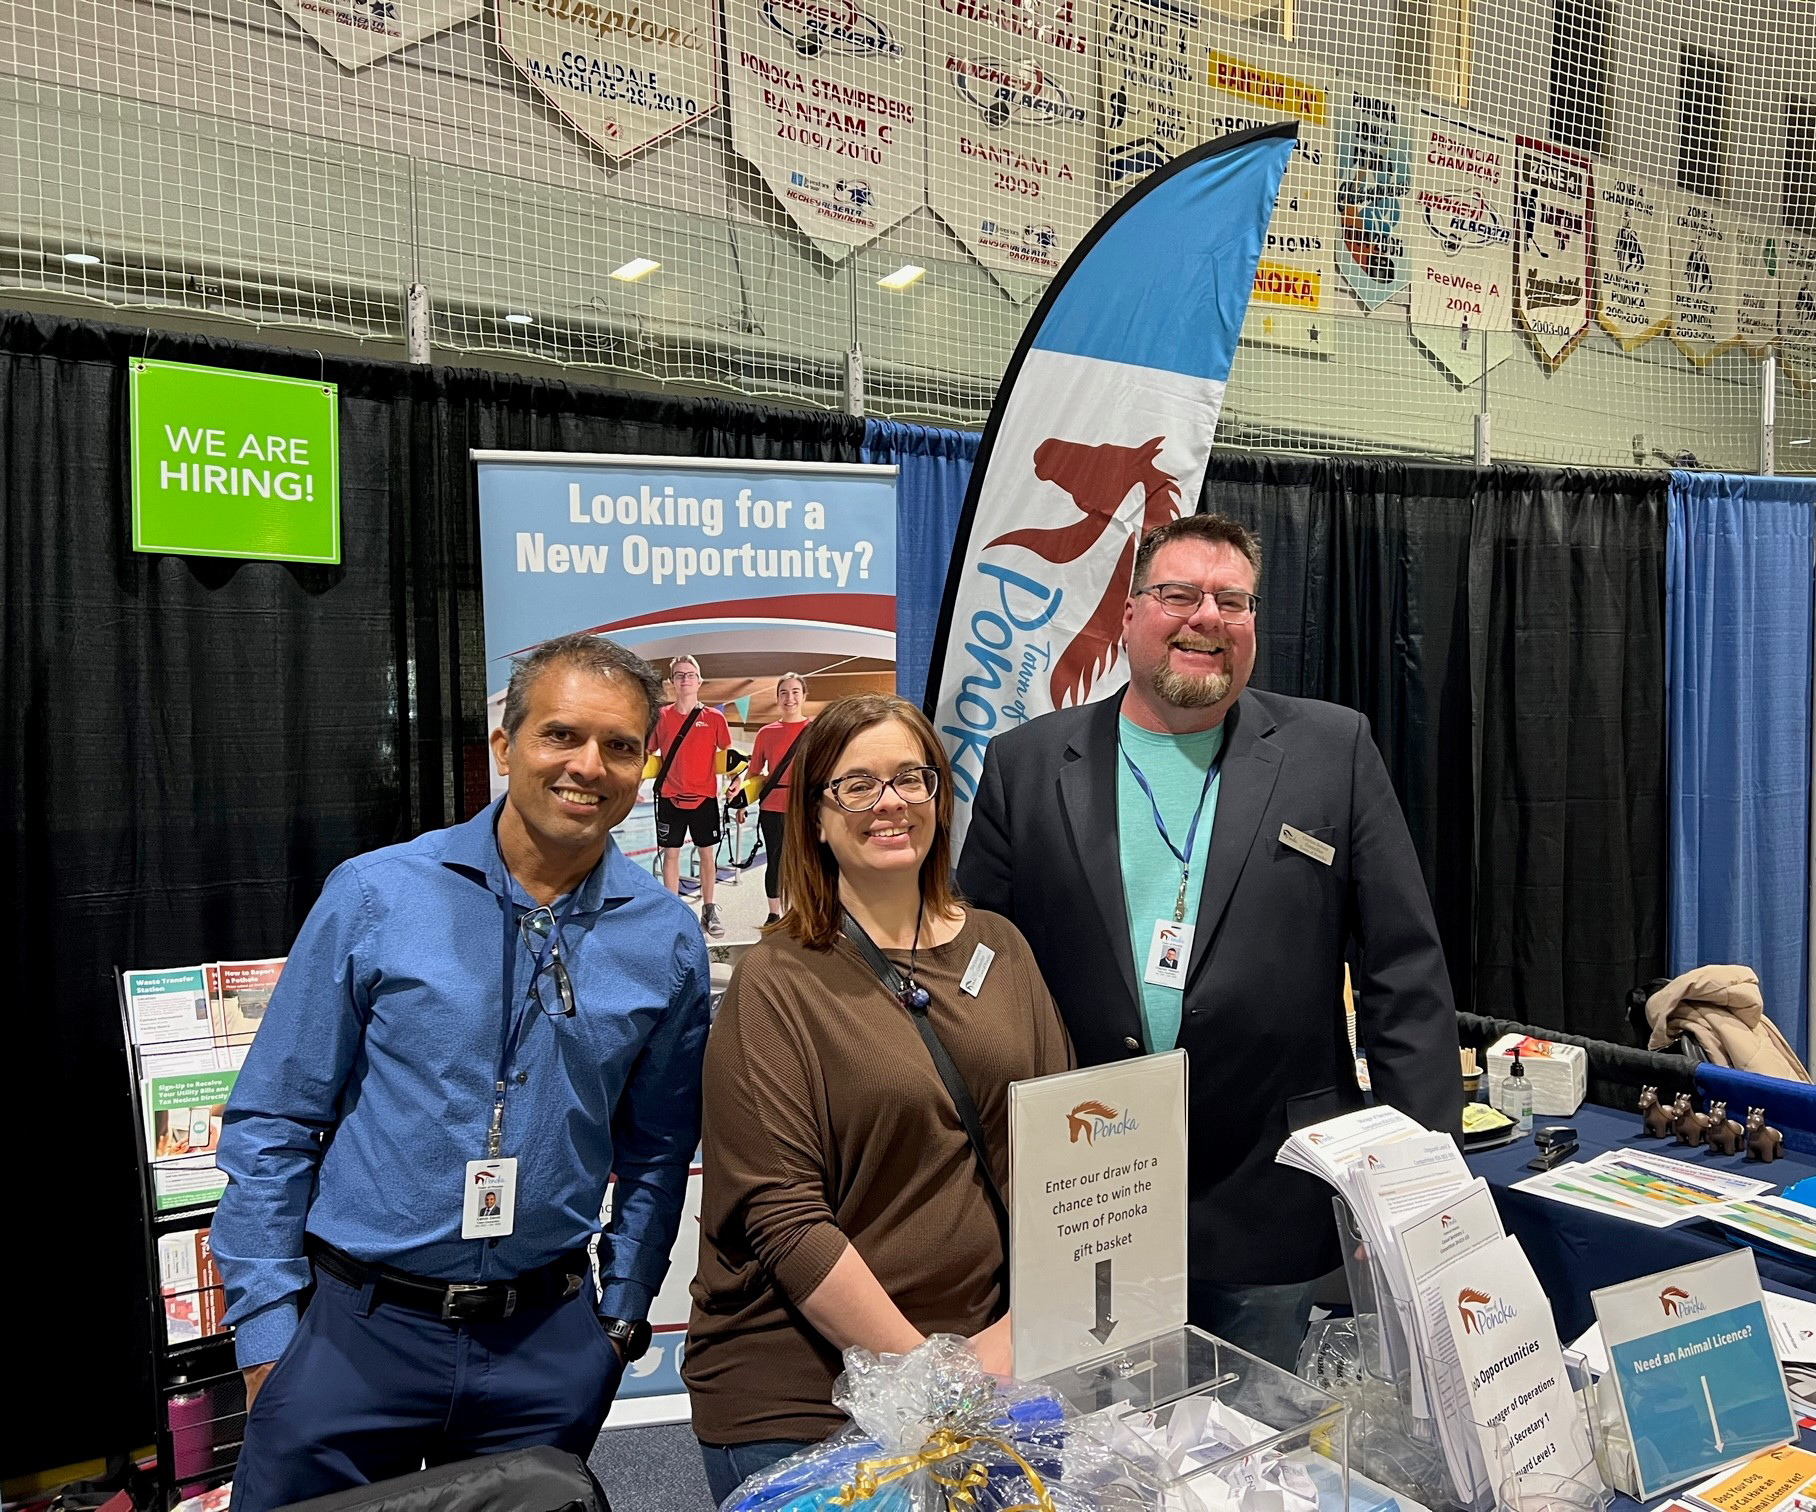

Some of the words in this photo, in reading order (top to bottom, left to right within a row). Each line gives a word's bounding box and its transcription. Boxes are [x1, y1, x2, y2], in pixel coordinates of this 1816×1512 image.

[510, 0, 703, 50] ampions
[1110, 4, 1168, 48] ZONE
[1176, 28, 1187, 54] 4
[562, 51, 657, 91] COALDALE
[946, 55, 1032, 92] HOCKEY
[1104, 35, 1192, 82] CHAMPIONS
[526, 58, 592, 95] MARCH
[740, 51, 804, 93] PONOKA
[812, 78, 915, 124] STAMPEDERS
[1218, 63, 1284, 105] BANTAM
[764, 88, 866, 137] BANTAM
[878, 125, 893, 145] C
[1353, 91, 1397, 124] PONOKA
[776, 119, 882, 165] 2009/2010
[1153, 117, 1186, 142] 2007
[960, 137, 1049, 175] BANTAM
[1058, 163, 1073, 180] A
[1430, 132, 1501, 166] PROVINCIAL
[994, 172, 1040, 197] 2009
[1427, 150, 1501, 185] CHAMPIONS
[1289, 196, 1298, 212] 4
[1602, 190, 1654, 216] CHAMPIONS
[1614, 181, 1637, 196] ZONE
[1267, 234, 1321, 252] PIONS
[1253, 269, 1315, 302] NOKA
[1427, 267, 1482, 294] PeeWee
[1489, 284, 1500, 297] A
[1445, 298, 1482, 316] 2004
[1531, 319, 1570, 337] 2003-04
[164, 424, 226, 457] WE
[237, 433, 310, 465] ARE
[160, 460, 314, 502] HIRING!
[568, 483, 724, 536] Looking
[736, 488, 792, 529] for
[804, 501, 825, 530] a
[515, 532, 609, 574] New
[622, 535, 874, 588] Opportunity?
[942, 562, 1063, 803] Ponoka
[1016, 641, 1050, 698] Town
[161, 976, 194, 984] Transfer
[251, 969, 275, 977] Report
[158, 1083, 186, 1091] Sign-Up
[173, 1096, 199, 1104] Notices
[200, 1093, 228, 1101] Directly
[1093, 1108, 1140, 1141] Ponoka
[1046, 1176, 1077, 1194] Enter
[1080, 1172, 1100, 1186] our
[1103, 1164, 1131, 1181] draw
[1133, 1158, 1149, 1173] for
[1151, 1157, 1158, 1167] a
[1052, 1197, 1093, 1215] chance
[1097, 1193, 1109, 1204] to
[1111, 1187, 1131, 1200] win
[1133, 1180, 1152, 1194] the
[1057, 1221, 1090, 1238] Town
[1092, 1215, 1104, 1228] of
[1107, 1203, 1148, 1225] Ponoka
[1073, 1245, 1093, 1262] gift
[1096, 1232, 1133, 1252] basket
[1476, 1297, 1517, 1335] Ponoka
[1678, 1296, 1706, 1318] Ponoka
[1479, 1340, 1540, 1384] Opportunities
[1633, 1353, 1662, 1374] Need
[1663, 1352, 1677, 1365] an
[1677, 1337, 1712, 1360] Animal
[1712, 1324, 1752, 1348] Licence?
[1486, 1406, 1510, 1428] Manager
[1511, 1397, 1519, 1411] of
[1518, 1377, 1555, 1406] Operations
[1514, 1417, 1545, 1444] Secretary
[1544, 1412, 1550, 1422] 1
[1532, 1445, 1551, 1466] Level
[1550, 1442, 1557, 1453] 3
[1713, 1491, 1733, 1504] Does
[1731, 1481, 1748, 1494] Your
[1746, 1473, 1764, 1485] Dog
[1730, 1502, 1741, 1511] or
[1736, 1493, 1752, 1506] Cat
[1749, 1484, 1767, 1498] Have
[1764, 1478, 1776, 1487] an
[1749, 1498, 1771, 1512] nimal
[1768, 1482, 1793, 1503] License
[1787, 1472, 1805, 1486] Yet?
